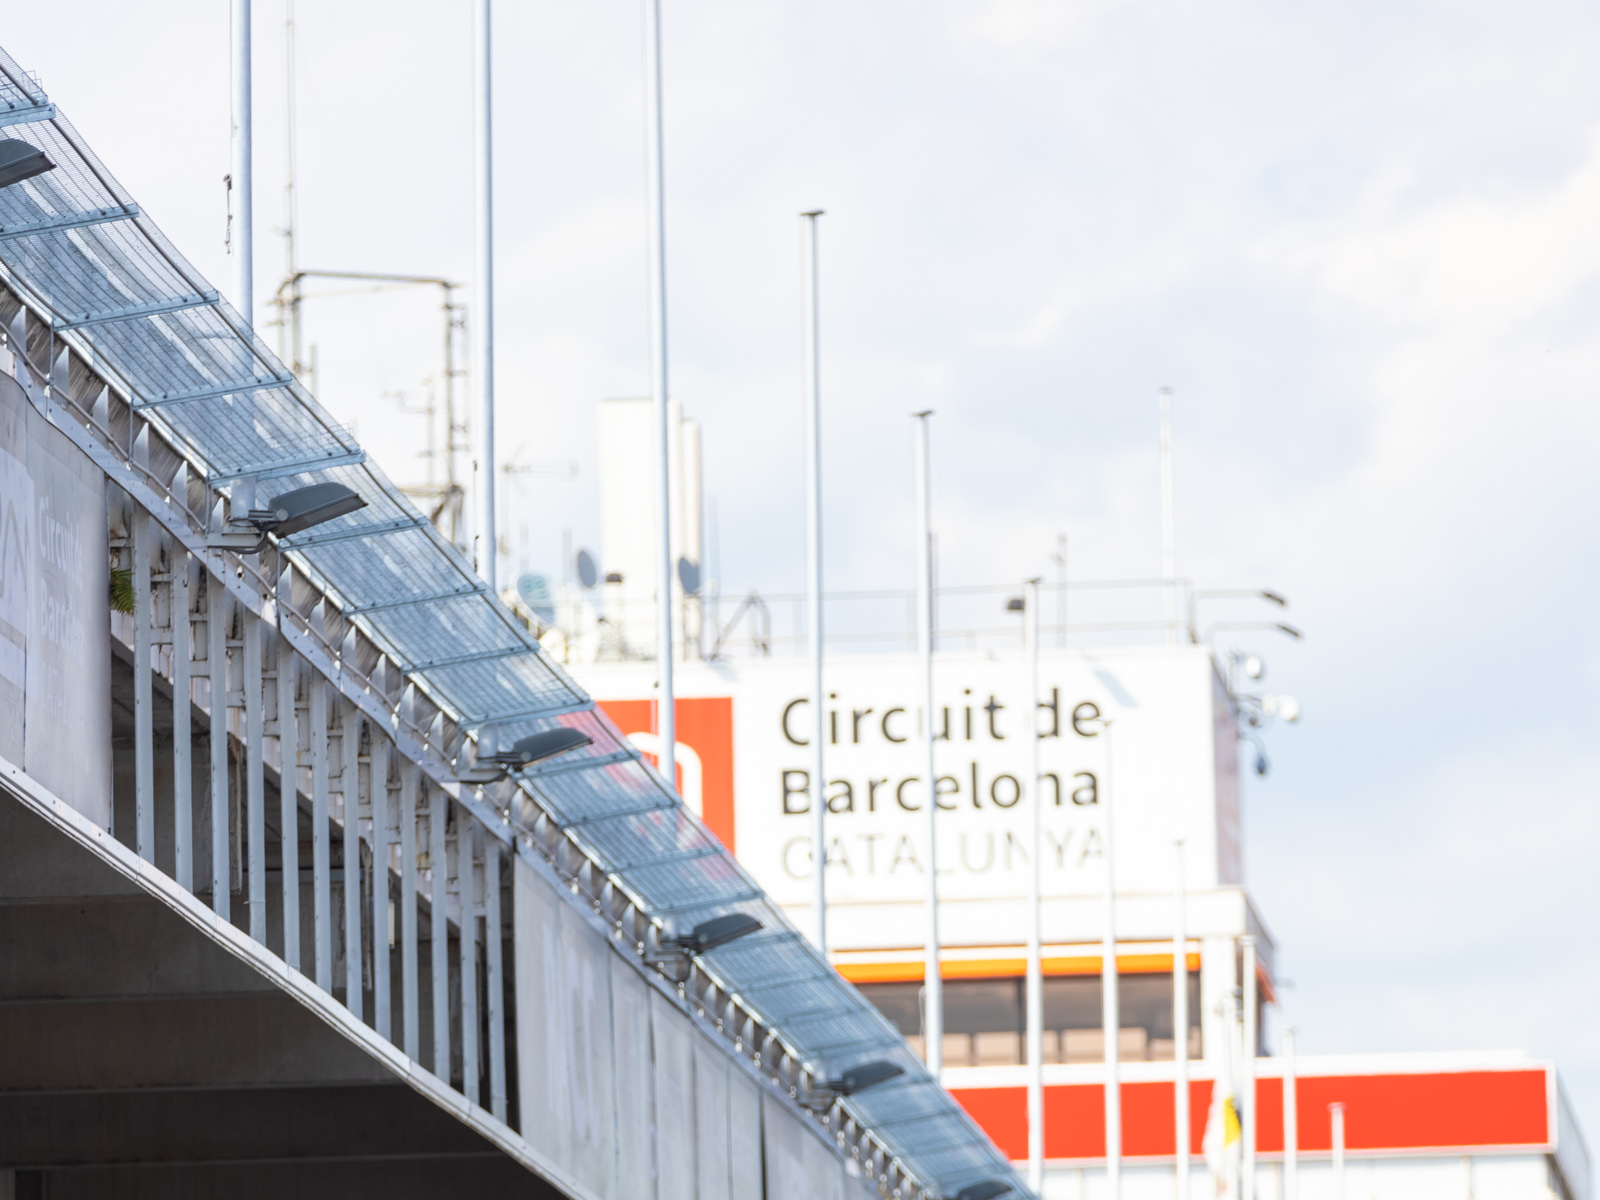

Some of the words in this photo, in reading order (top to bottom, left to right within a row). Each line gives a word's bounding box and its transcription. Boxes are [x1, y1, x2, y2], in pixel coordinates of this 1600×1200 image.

[39, 577, 84, 669] Barcel
[781, 688, 1006, 747] Circuit
[1035, 686, 1101, 739] de
[781, 760, 1100, 816] Barcelona
